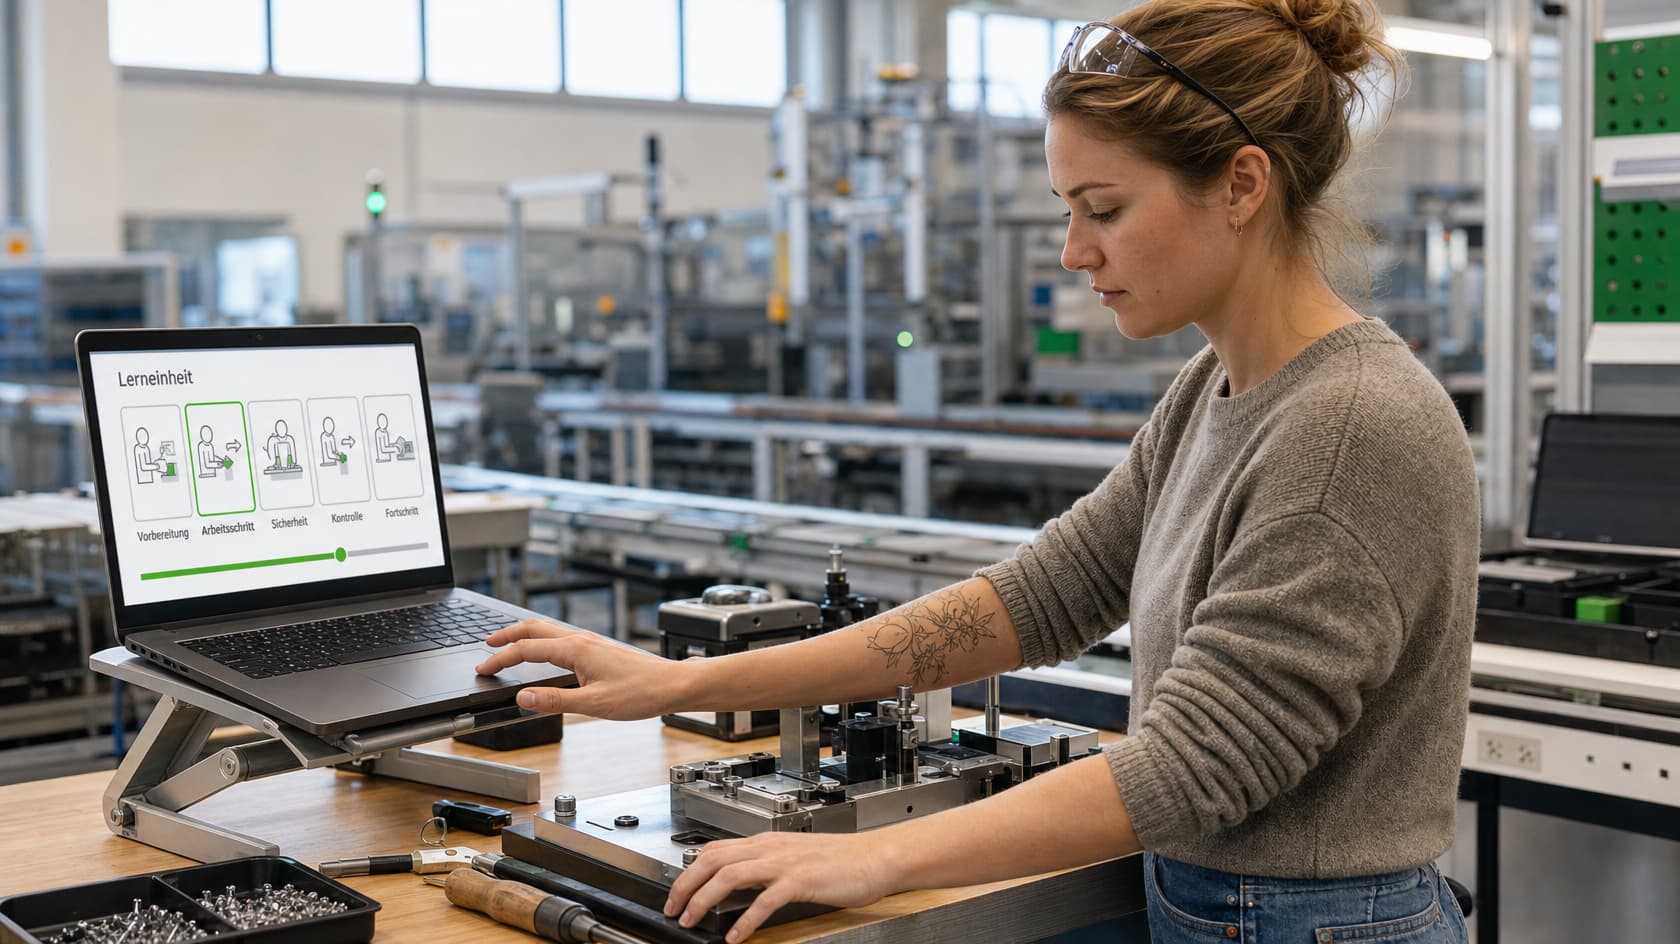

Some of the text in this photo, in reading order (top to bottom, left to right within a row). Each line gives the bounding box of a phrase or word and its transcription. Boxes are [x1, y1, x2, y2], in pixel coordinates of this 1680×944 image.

[118, 369, 194, 388] Lerneinheit
[331, 510, 364, 524] Kontrolle
[385, 507, 419, 519] Fortschritt
[201, 521, 256, 537] Arbeitsschritt
[271, 515, 309, 530] Sicherheit
[137, 527, 190, 543] Vorbereitung
